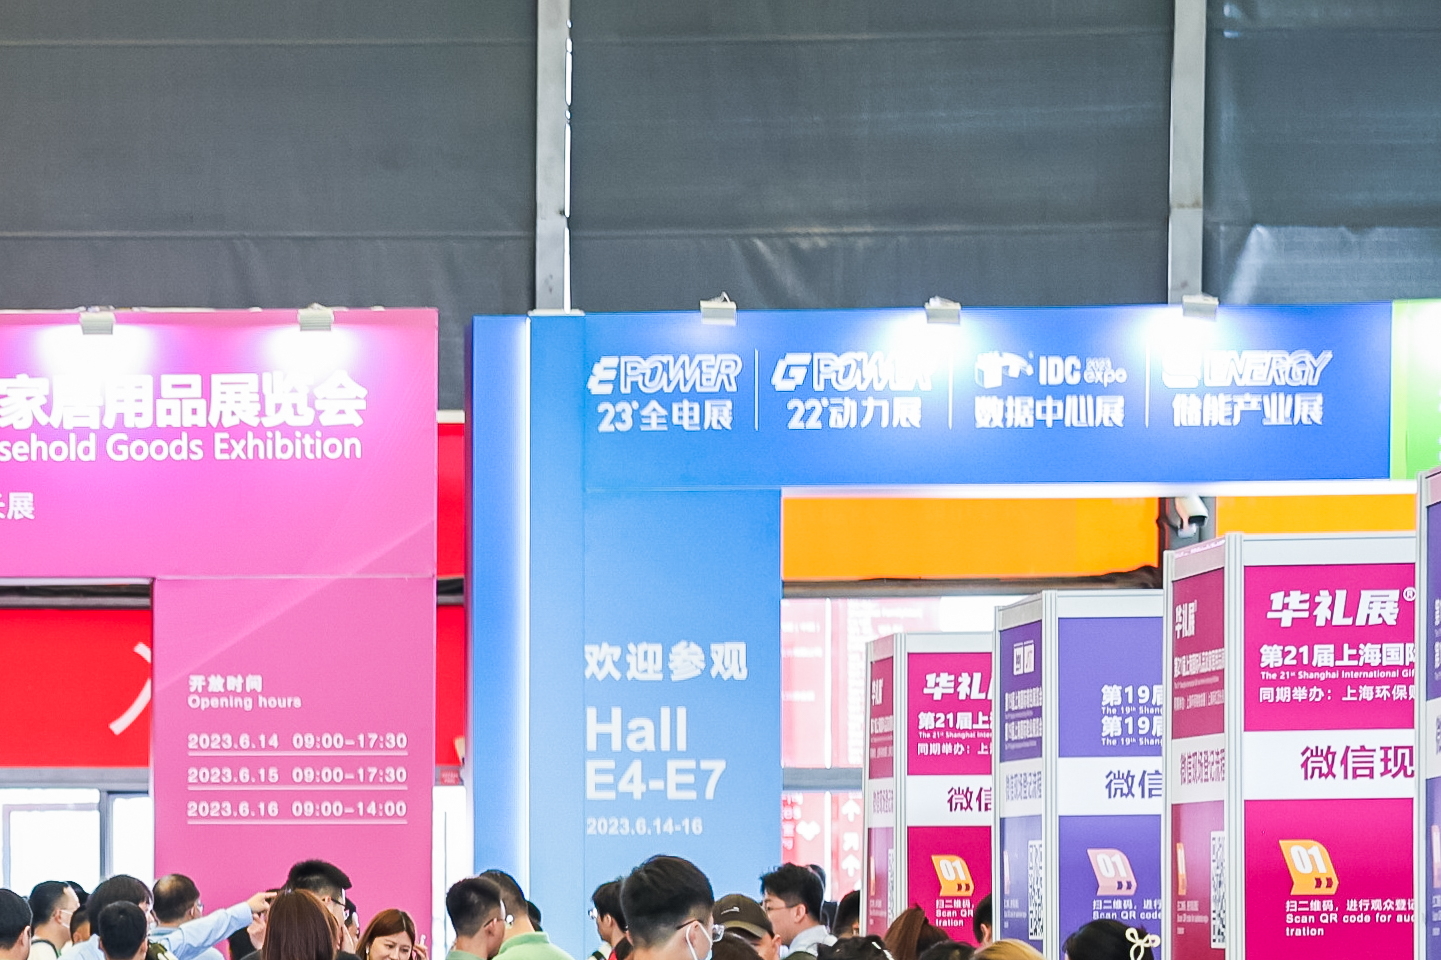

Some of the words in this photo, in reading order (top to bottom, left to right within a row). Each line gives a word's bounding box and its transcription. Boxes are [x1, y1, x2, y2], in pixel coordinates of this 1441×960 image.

[1039, 355, 1082, 386] IDC
[105, 431, 204, 462] Goods
[213, 430, 362, 460] Exhibition
[584, 640, 748, 682] 欢迎参观
[188, 674, 263, 693] 开放时间
[1261, 670, 1277, 680] The
[1298, 670, 1339, 682] Shanghai
[1341, 668, 1399, 679] International
[923, 672, 992, 701] 华礼
[188, 694, 253, 711] Opening
[258, 694, 302, 709] hours
[586, 706, 687, 752] Hall
[918, 711, 992, 730] 第21届上
[187, 733, 279, 750] 2023.6.14
[292, 733, 408, 750] 09:00-17:30
[1300, 745, 1414, 781] 微信现
[187, 766, 279, 784] 2023.6.15
[292, 766, 408, 784] 09:00-17:30
[586, 759, 727, 800] E4-E7
[187, 800, 279, 817] 2023.6.16
[292, 800, 408, 817] 09:00-14:00
[586, 817, 703, 836] 2023.6.14-16
[1097, 853, 1127, 878] 01
[1290, 845, 1327, 874] 01
[939, 859, 966, 881] 01
[1285, 913, 1315, 924] Scan
[1319, 913, 1338, 924] QR
[1343, 913, 1371, 923] code
[1375, 913, 1392, 923] for
[1285, 926, 1324, 937] tration
